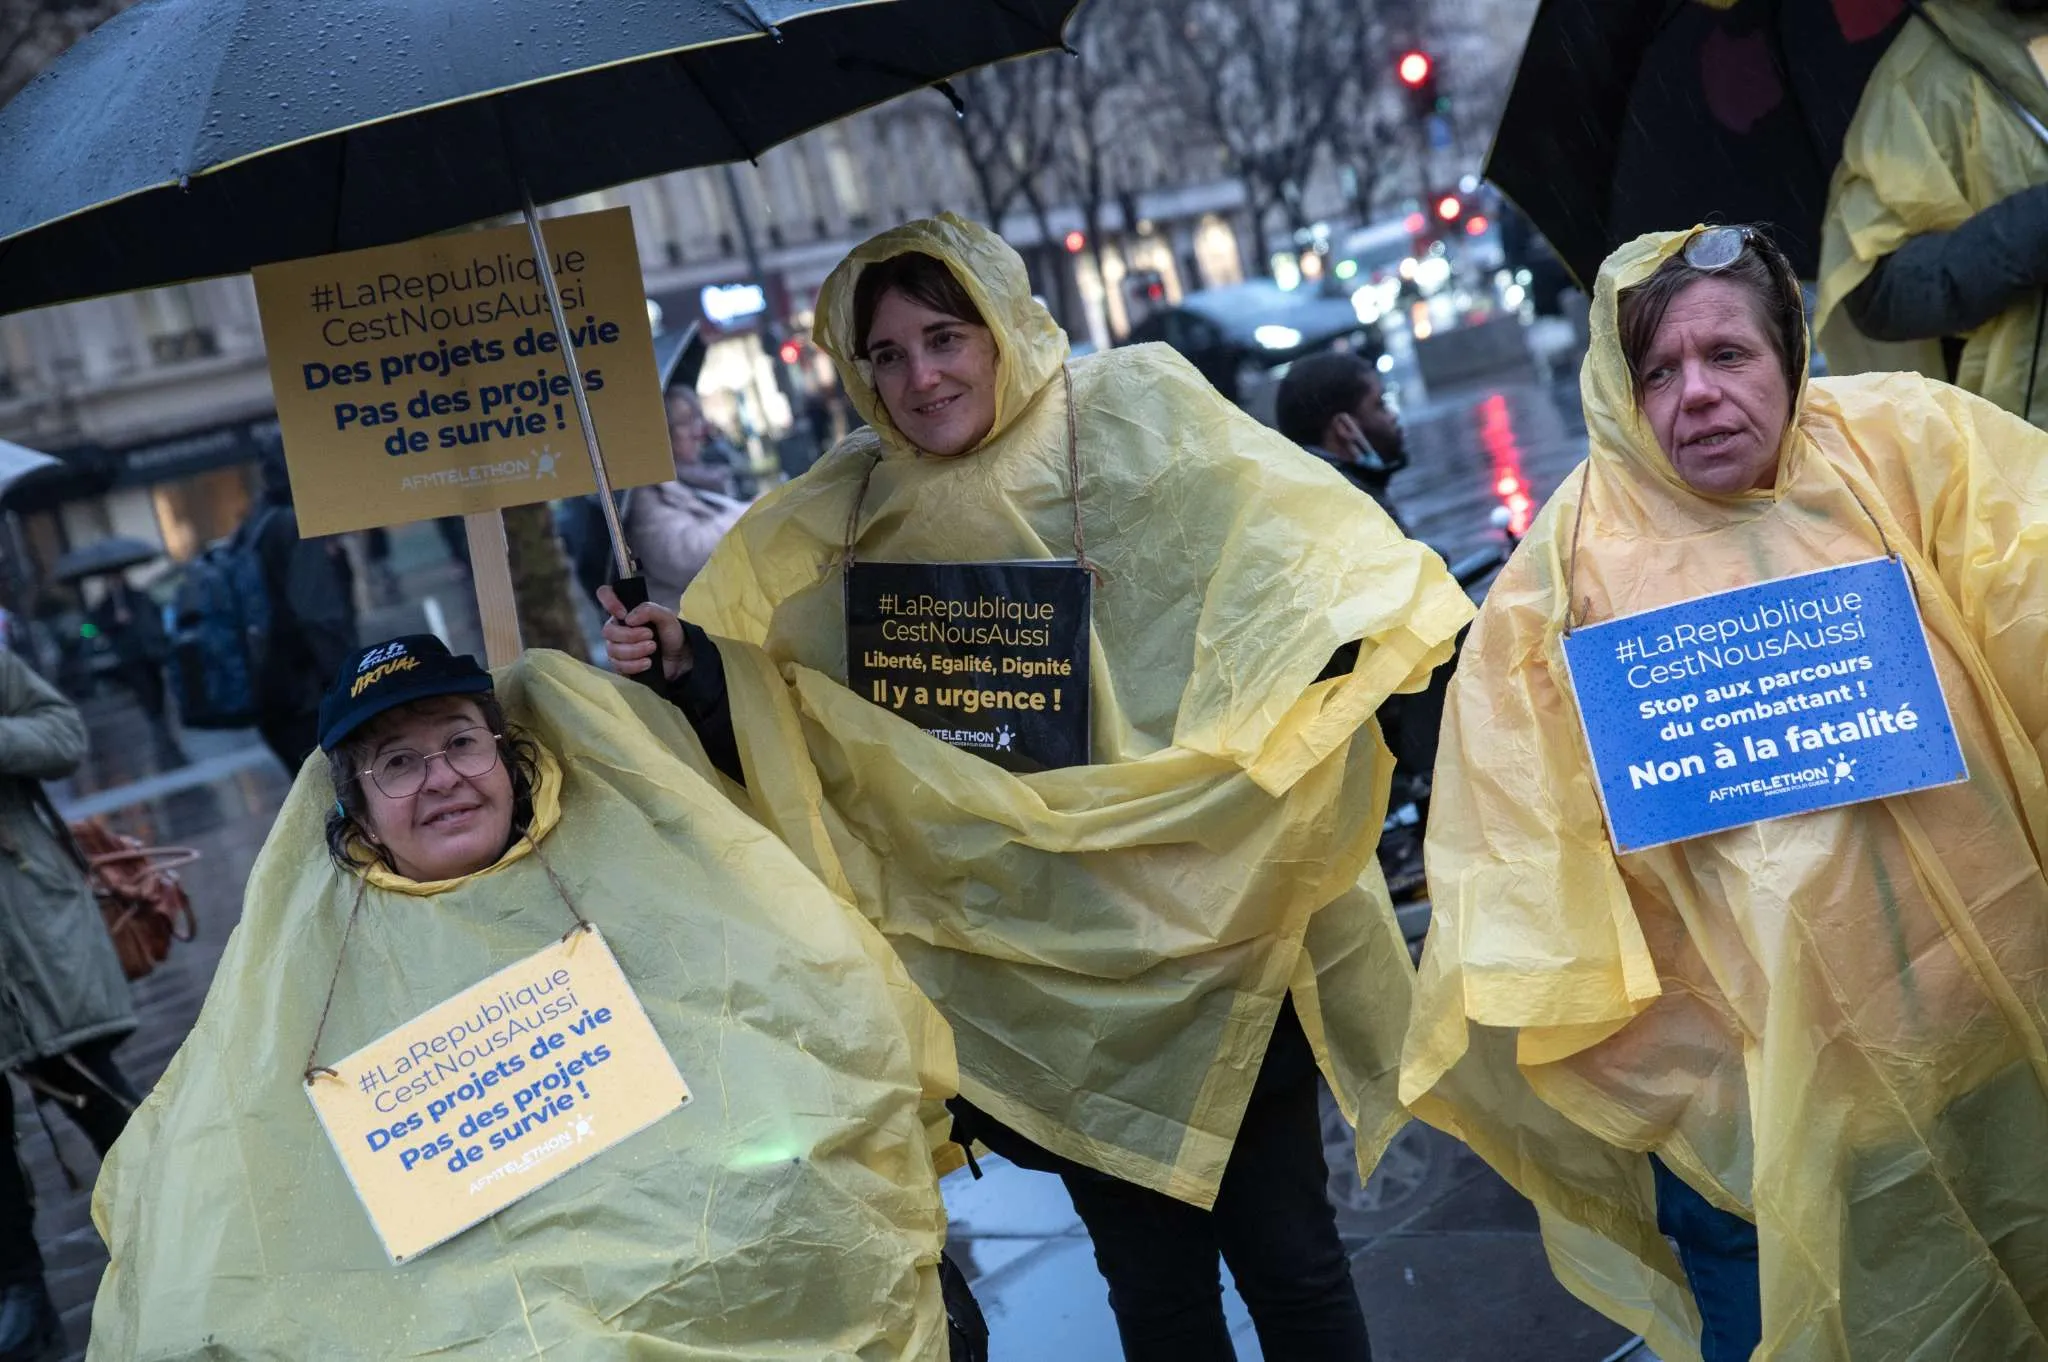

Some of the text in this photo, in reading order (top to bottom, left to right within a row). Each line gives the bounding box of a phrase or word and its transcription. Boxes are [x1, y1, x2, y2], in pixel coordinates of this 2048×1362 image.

[302, 315, 621, 390] Des projets de vie
[334, 367, 604, 430] Pas des projes
[384, 403, 566, 456] de survie !
[879, 594, 1054, 624] #LaRepublique
[882, 619, 1049, 646] CestNousAussi
[1615, 591, 1863, 664] #LaRepublique
[864, 650, 1072, 678] Liberté, Egalité, Dignité
[1627, 615, 1866, 689] CestNousAussi
[1638, 654, 1873, 721] Stop aux parcours
[873, 679, 1061, 713] Il y a urgence !
[1660, 681, 1867, 743] du combattant !
[1627, 703, 1920, 790] Non à la fatalité
[359, 967, 570, 1095] #LaRepublique
[374, 987, 579, 1114] CestNousAussi
[365, 1005, 613, 1153] Des projets de vie
[398, 1042, 612, 1172] Pas des projets
[446, 1080, 591, 1174] de survie !
